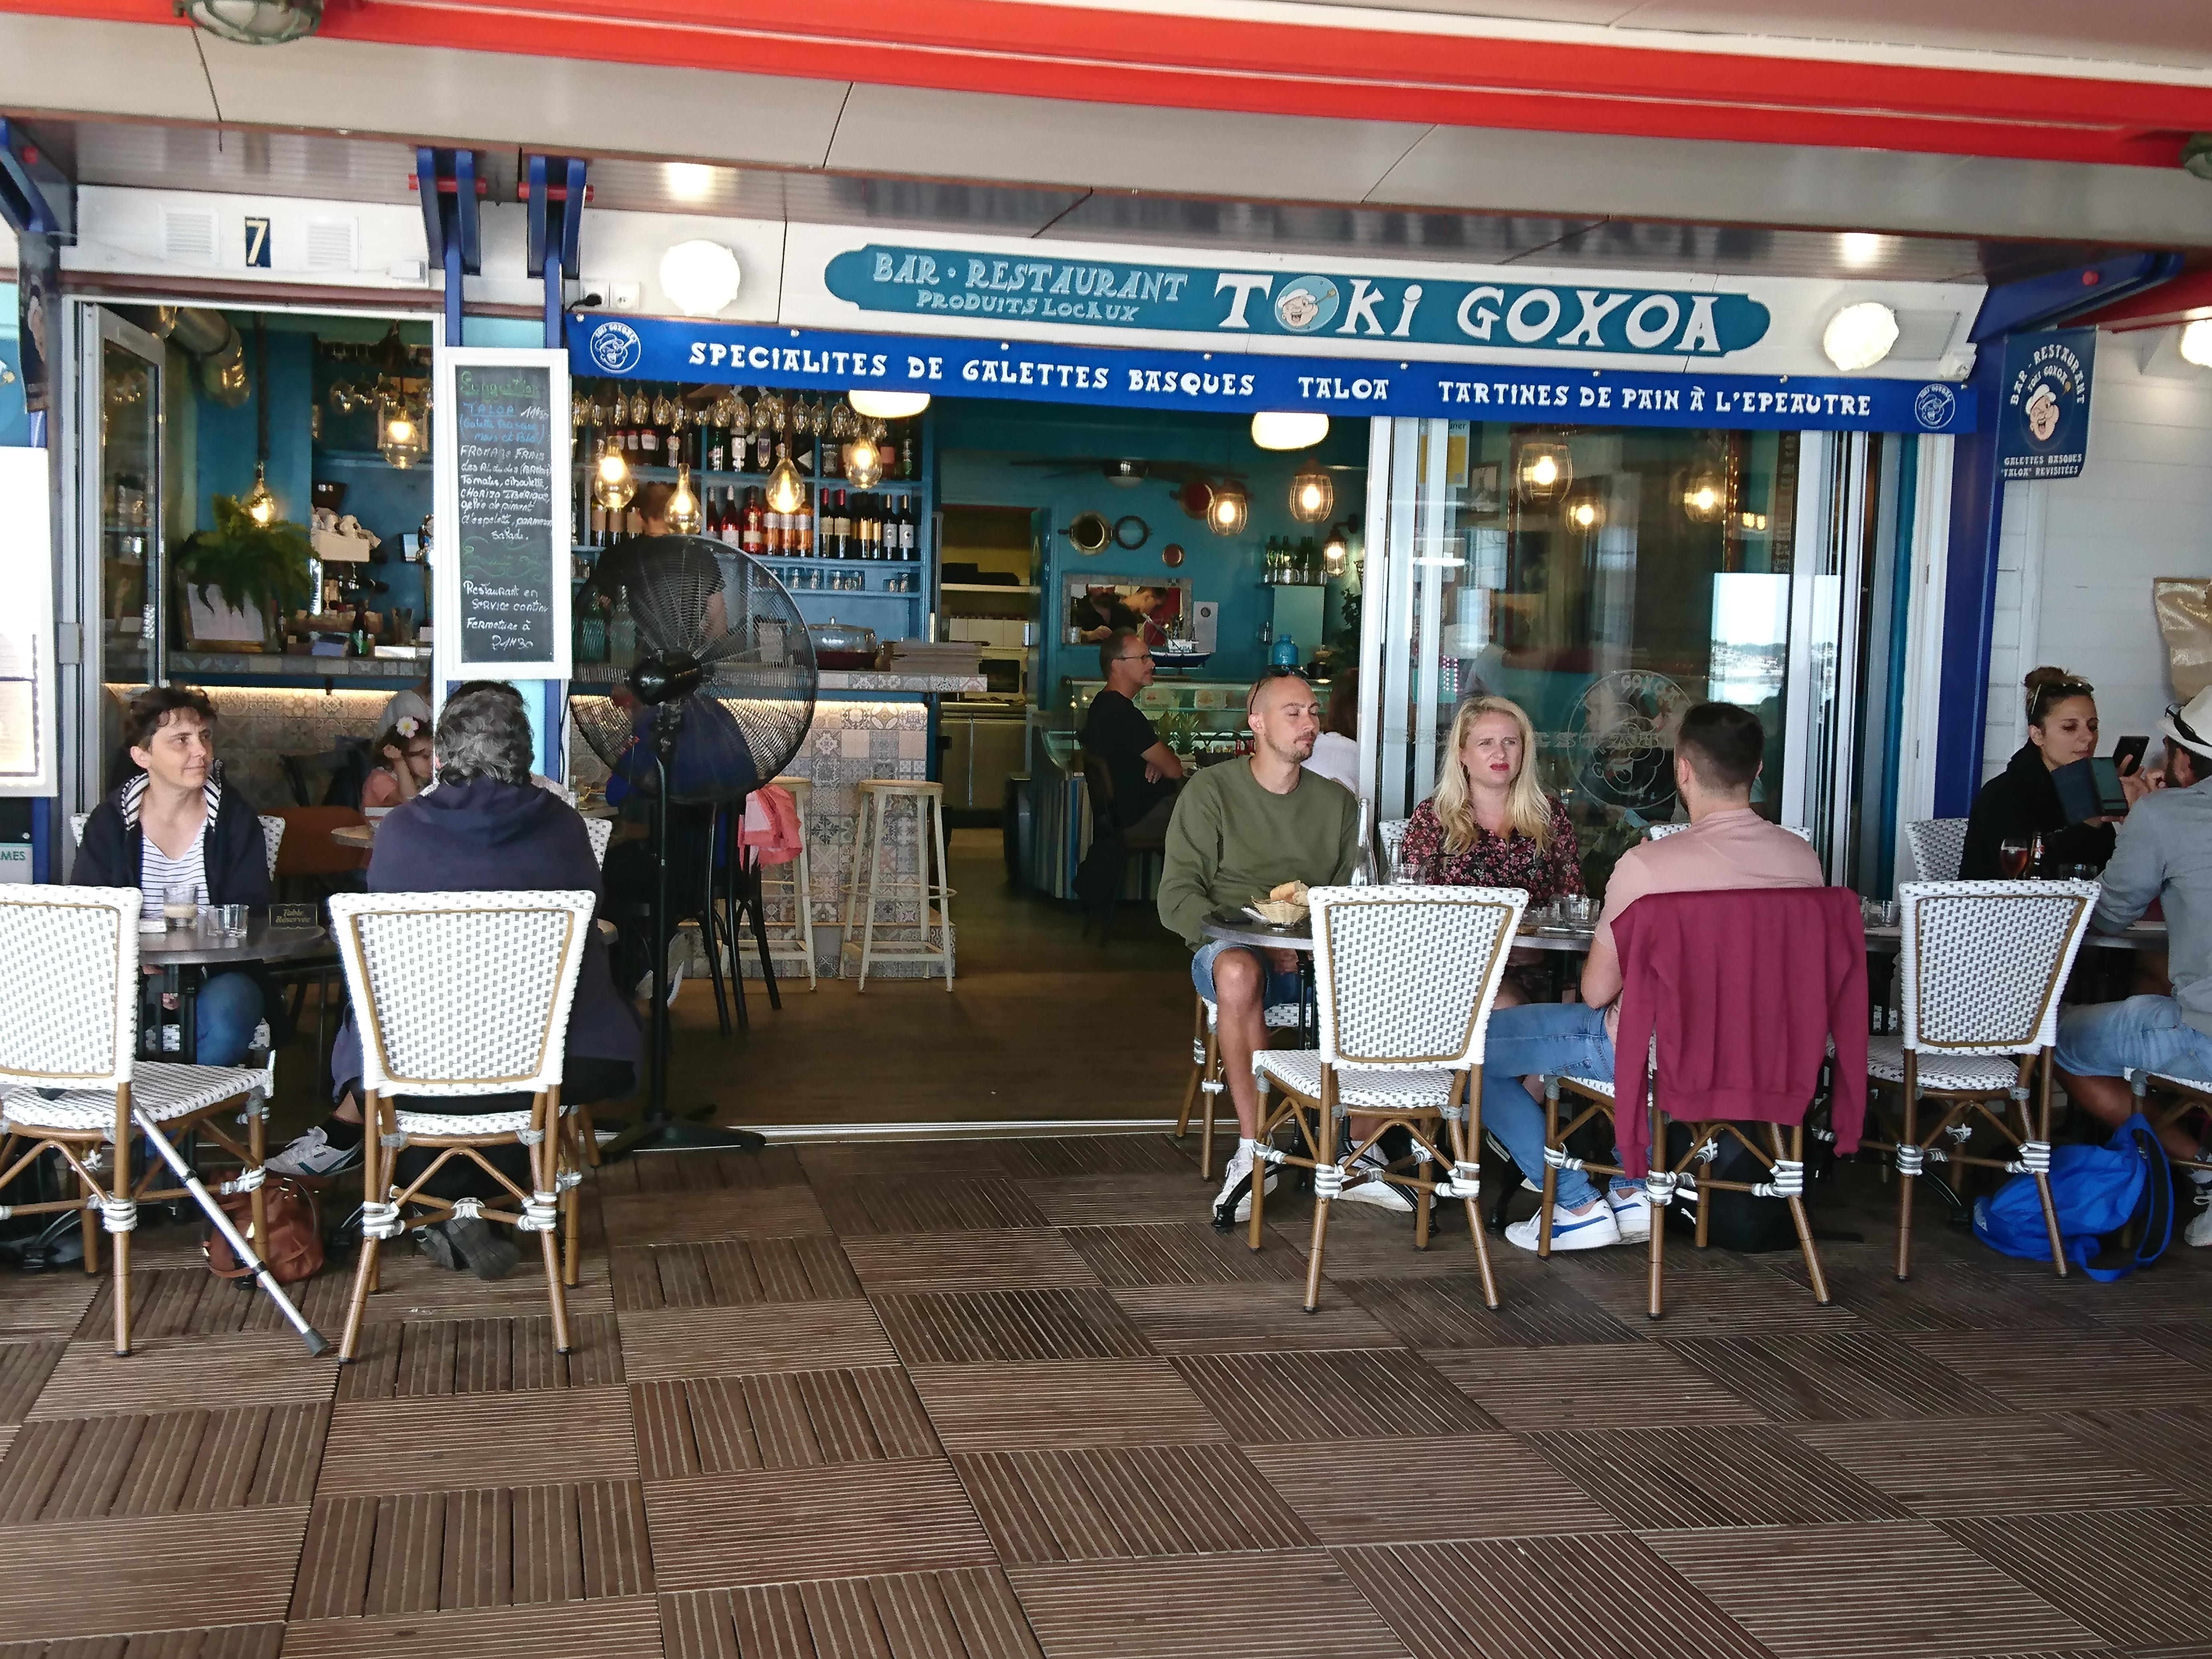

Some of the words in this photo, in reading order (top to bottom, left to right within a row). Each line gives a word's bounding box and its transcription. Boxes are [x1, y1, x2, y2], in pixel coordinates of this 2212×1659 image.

[246, 220, 268, 264] 7
[873, 252, 940, 285] BAR
[965, 258, 1188, 303] RESTAURANT
[916, 289, 1037, 315] PRODUITS
[1042, 298, 1140, 321] LOCAUX
[1457, 286, 1721, 353] GOXOA
[688, 342, 888, 377] SPECIALITES
[908, 356, 943, 379] DE
[962, 359, 1109, 389] GALETTES
[1128, 369, 1255, 396] BASQUES
[1298, 376, 1389, 400] TALOA
[1438, 381, 1570, 406] TARTINES
[1579, 386, 1612, 408] DE
[1622, 388, 1679, 410] PAIN
[1690, 385, 1705, 411] À
[1716, 391, 1871, 416] L'EPEAUTRE
[2004, 456, 2044, 466] GALETTES
[2048, 454, 2082, 464] BASQUES
[524, 589, 538, 598] en
[522, 620, 531, 631] à
